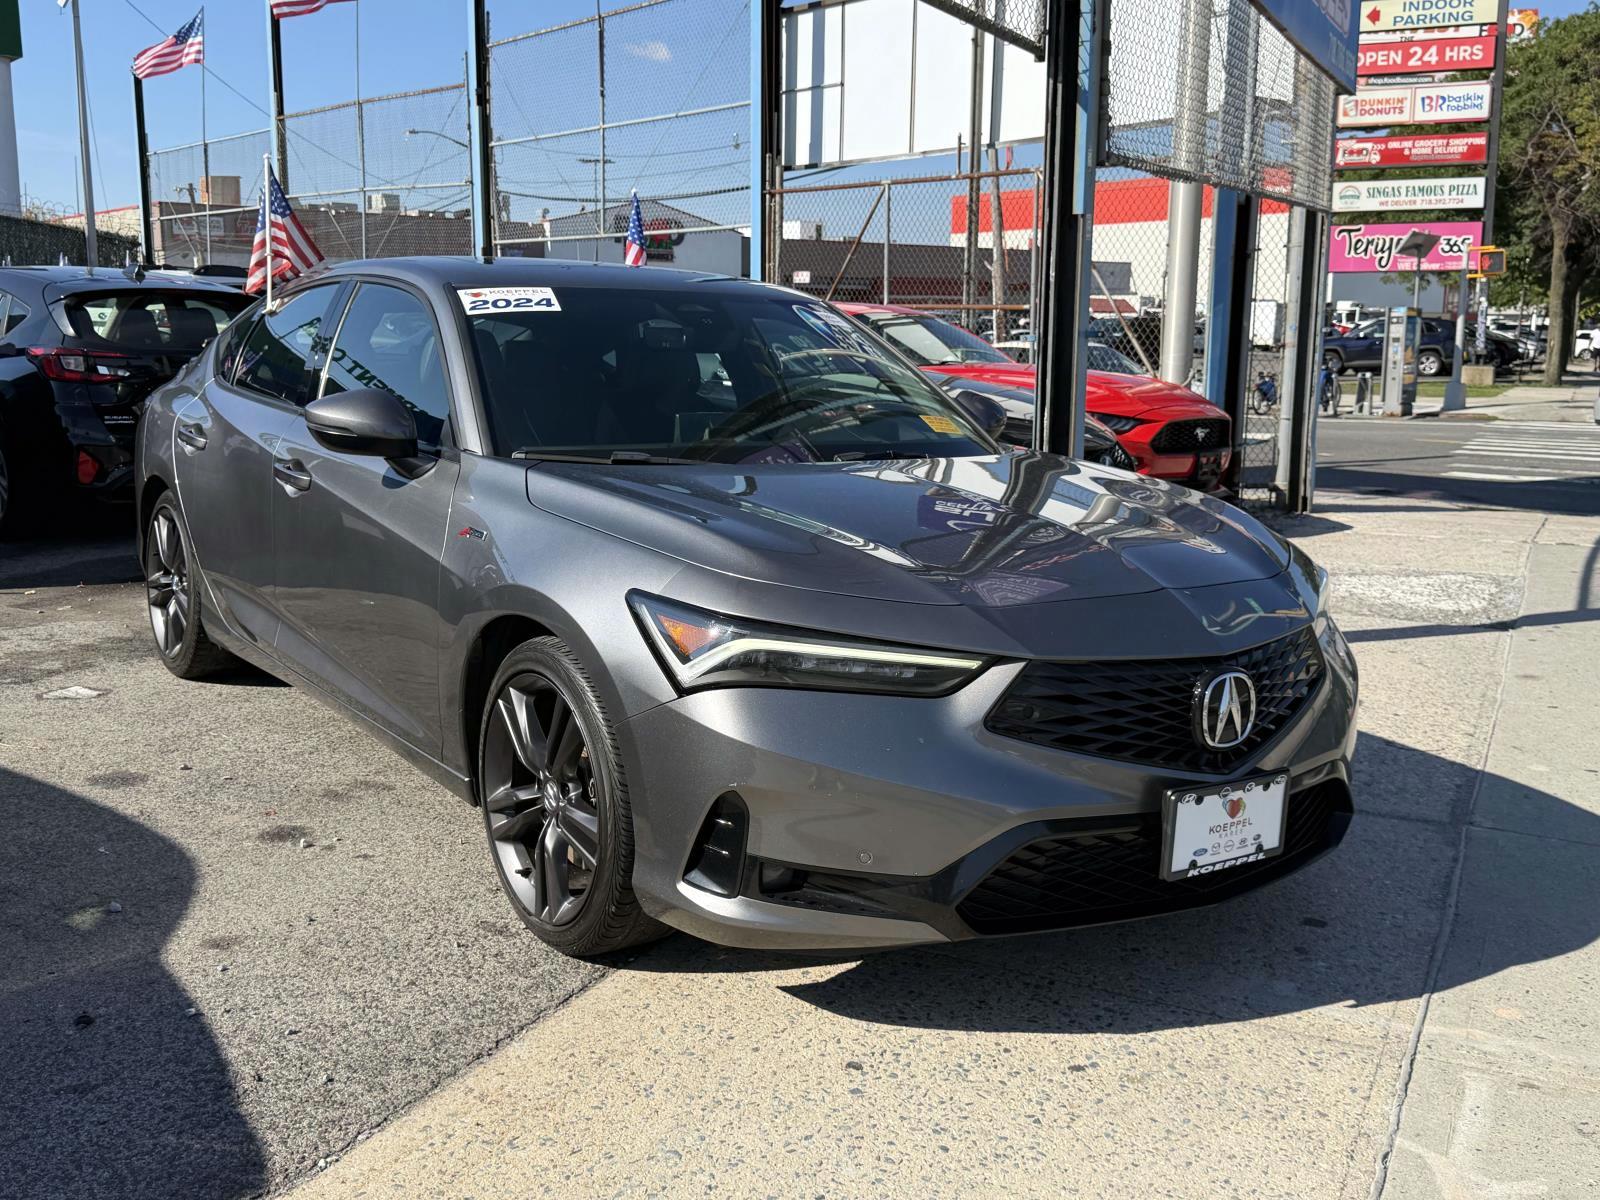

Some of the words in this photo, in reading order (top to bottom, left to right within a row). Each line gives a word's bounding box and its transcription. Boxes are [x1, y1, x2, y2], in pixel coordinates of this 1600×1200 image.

[1402, 0, 1474, 12] INDOOR
[1393, 11, 1474, 26] PARKING
[1408, 45, 1439, 66] 24
[1445, 44, 1484, 62] HRS
[1447, 92, 1484, 103] baskin
[1421, 95, 1447, 113] BR
[1447, 101, 1484, 112] robbins
[1359, 106, 1404, 117] DONUTS
[1387, 141, 1413, 149] ONLINE
[1414, 139, 1448, 148] GROCERY
[1448, 137, 1486, 146] SHOPPING
[1433, 145, 1468, 153] DELIVERY
[1366, 186, 1402, 198] SINGAS
[1405, 184, 1445, 196] FAMOUS
[1449, 183, 1478, 196] PIZZA
[1391, 199, 1417, 207] DELIVER
[468, 298, 555, 311] 2024
[1208, 817, 1253, 835] KOEPPEL
[1187, 853, 1265, 877] KOEPPEL
